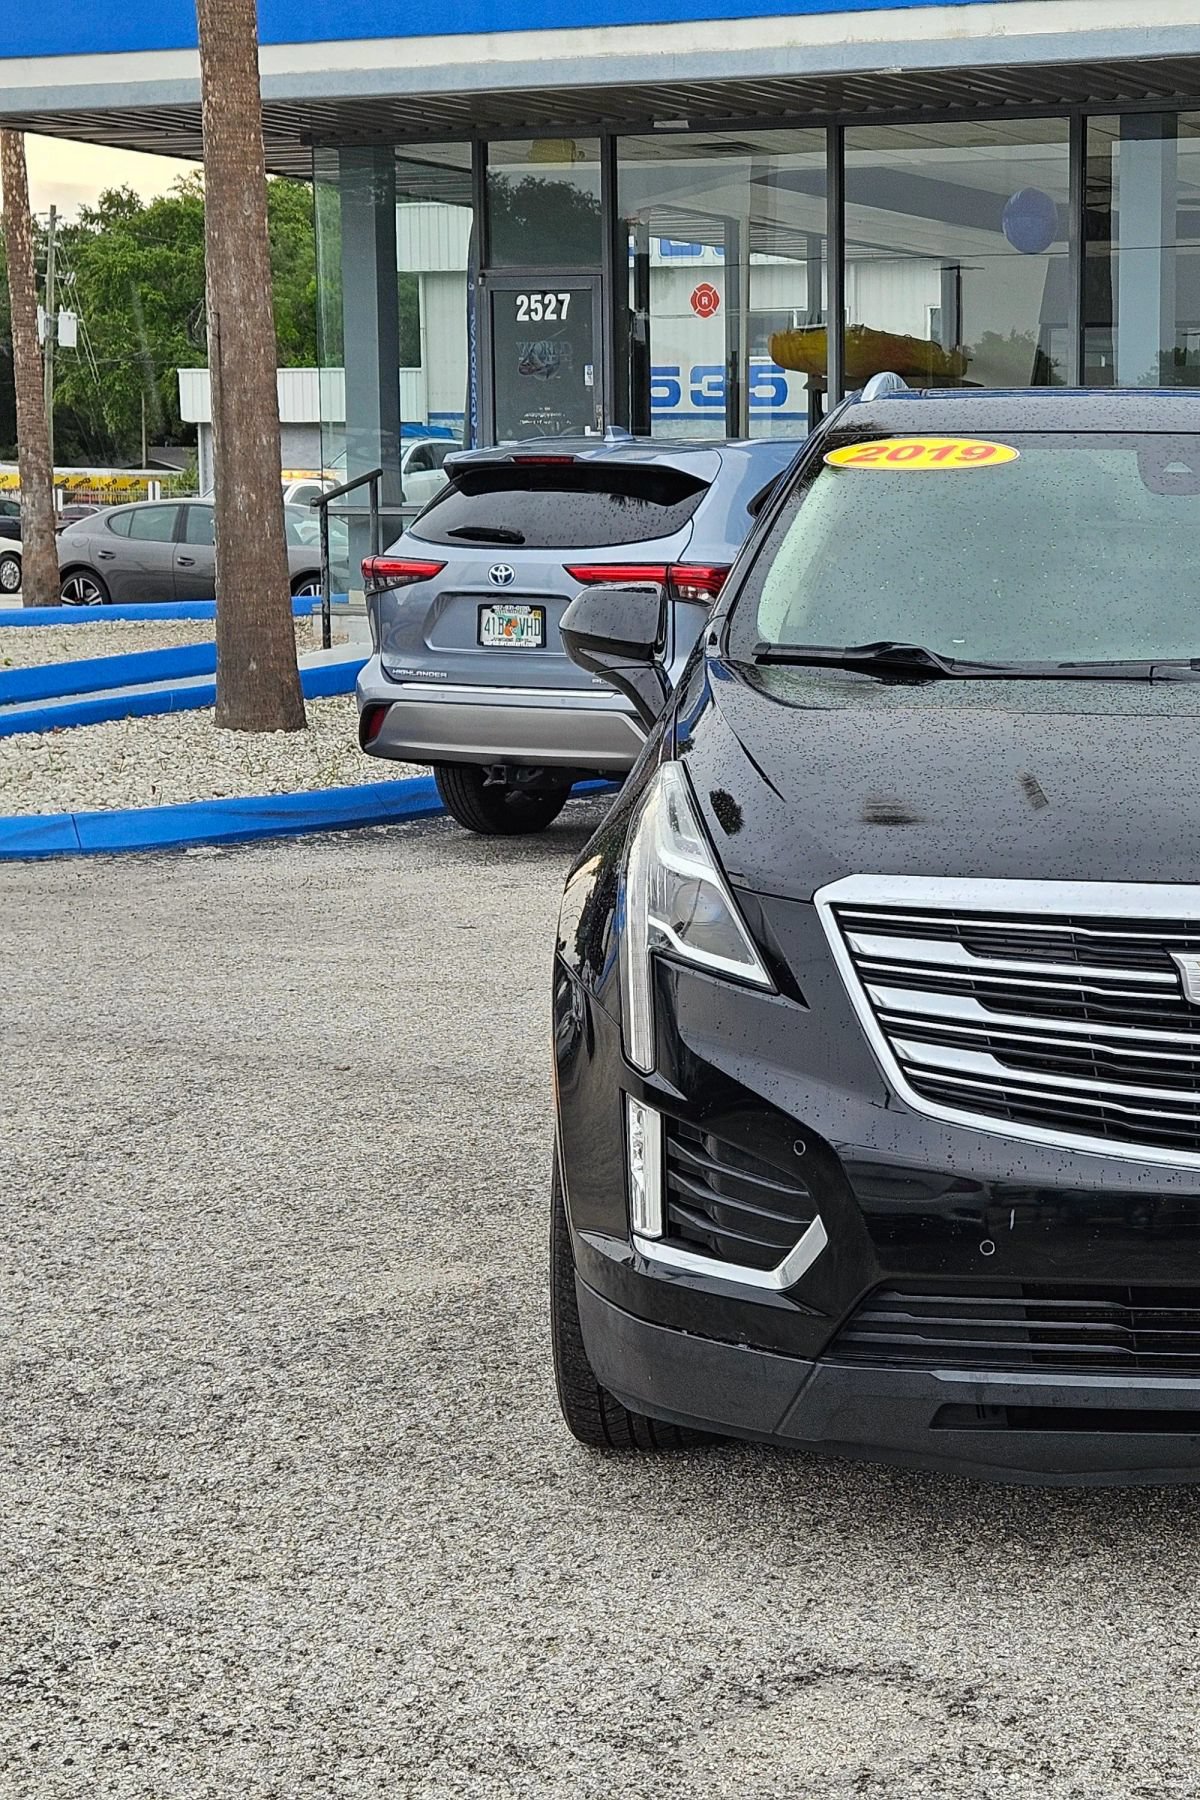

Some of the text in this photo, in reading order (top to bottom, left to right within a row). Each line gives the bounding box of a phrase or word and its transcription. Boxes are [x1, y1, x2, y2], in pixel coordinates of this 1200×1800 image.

[516, 293, 571, 321] 2527
[701, 296, 709, 305] R
[844, 445, 997, 463] 2019
[392, 669, 448, 678] HIGHLANDER
